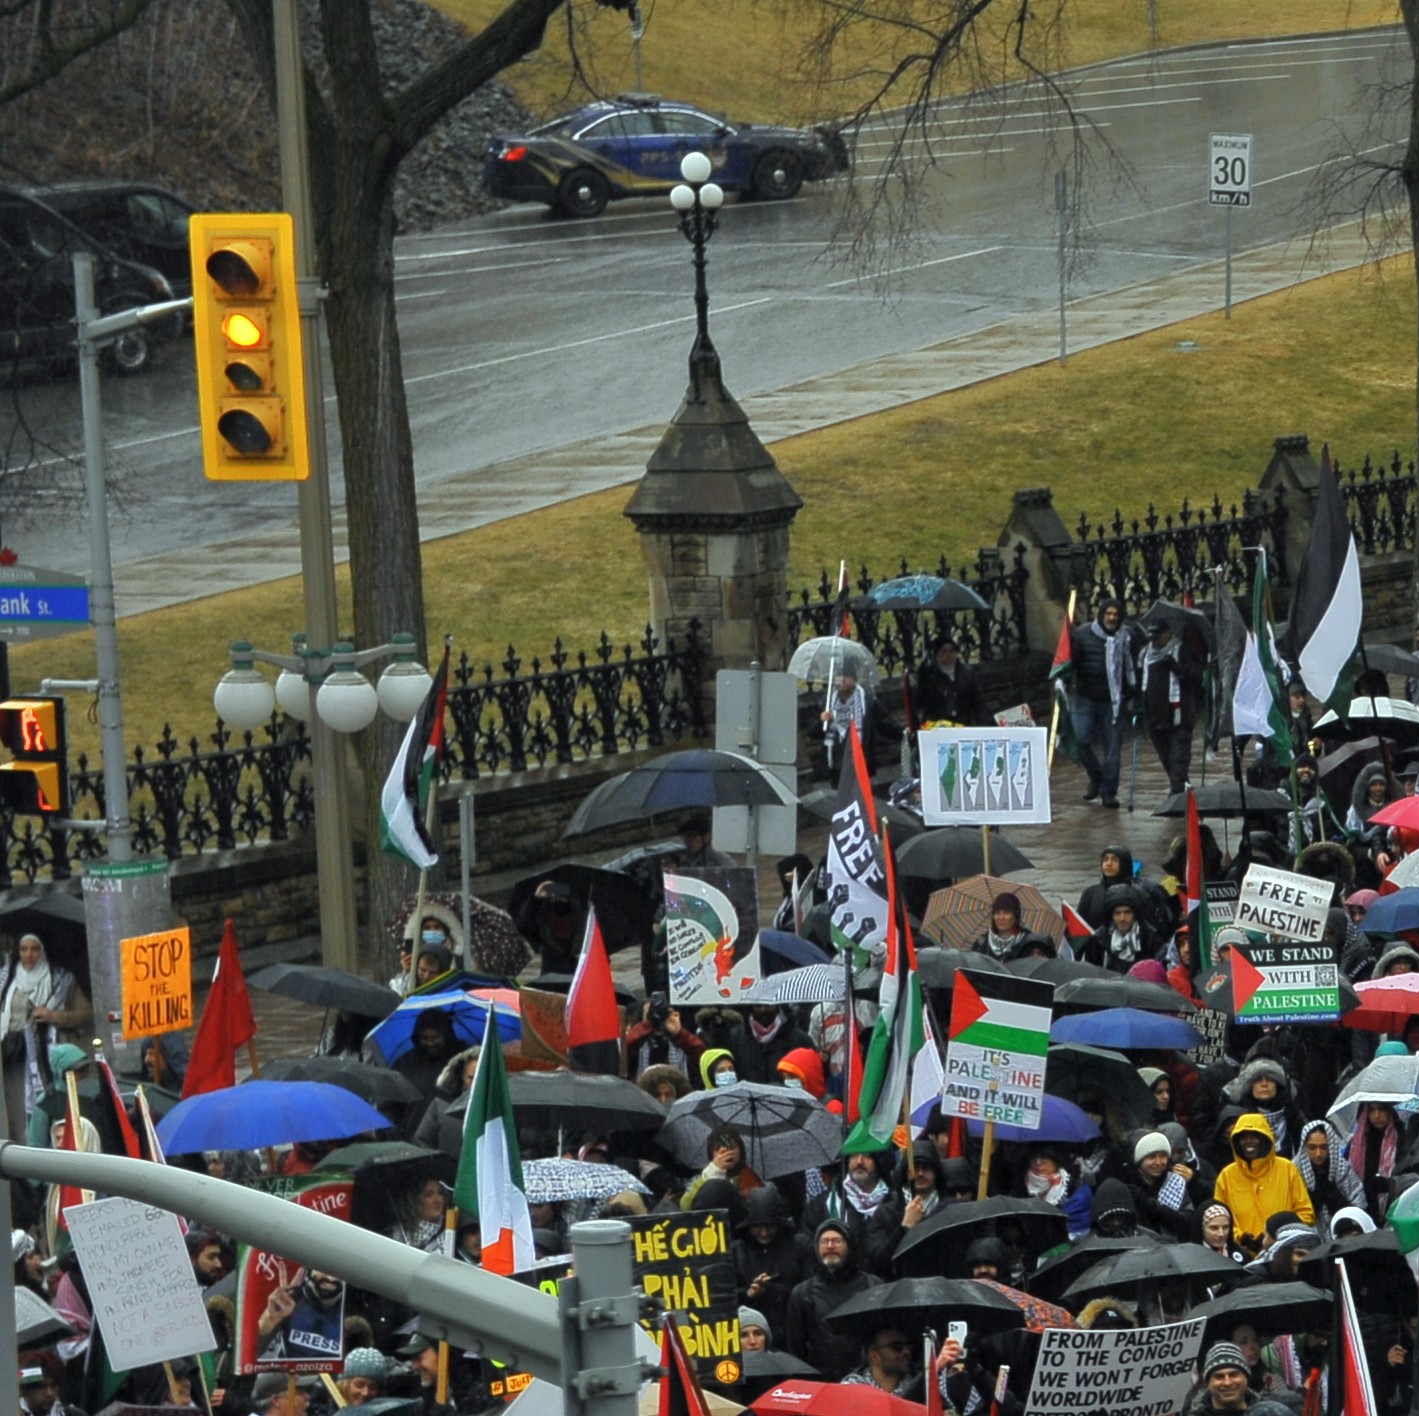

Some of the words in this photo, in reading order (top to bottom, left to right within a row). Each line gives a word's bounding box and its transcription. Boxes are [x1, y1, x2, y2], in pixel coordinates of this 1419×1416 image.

[1214, 155, 1247, 187] 30
[1211, 192, 1249, 206] km/h
[0, 591, 31, 616] ank
[832, 799, 885, 887] FREE
[1258, 880, 1307, 909] FREE
[1238, 902, 1321, 939] PALESTINE
[134, 937, 183, 982] STOP
[1249, 947, 1276, 963] WE
[1280, 945, 1334, 962] STAND
[150, 983, 170, 996] THE
[1268, 969, 1312, 985] WITH
[128, 994, 189, 1031] KILLING
[1252, 992, 1337, 1009] PALESTINE
[948, 1060, 1042, 1088] PALESTINE
[958, 1101, 979, 1116] BE
[983, 1103, 1024, 1123] FREE
[633, 1219, 670, 1263] HẾ
[291, 1331, 341, 1352] PRESS
[684, 1311, 741, 1356] BÌNH
[1045, 1331, 1106, 1349] FROM
[1114, 1323, 1201, 1347] PALESTINE
[1040, 1350, 1067, 1367] TO
[1075, 1349, 1109, 1367] THE
[1117, 1342, 1184, 1366] CONGO
[1036, 1370, 1067, 1388] WE
[1030, 1386, 1143, 1410] WORLDWIDE
